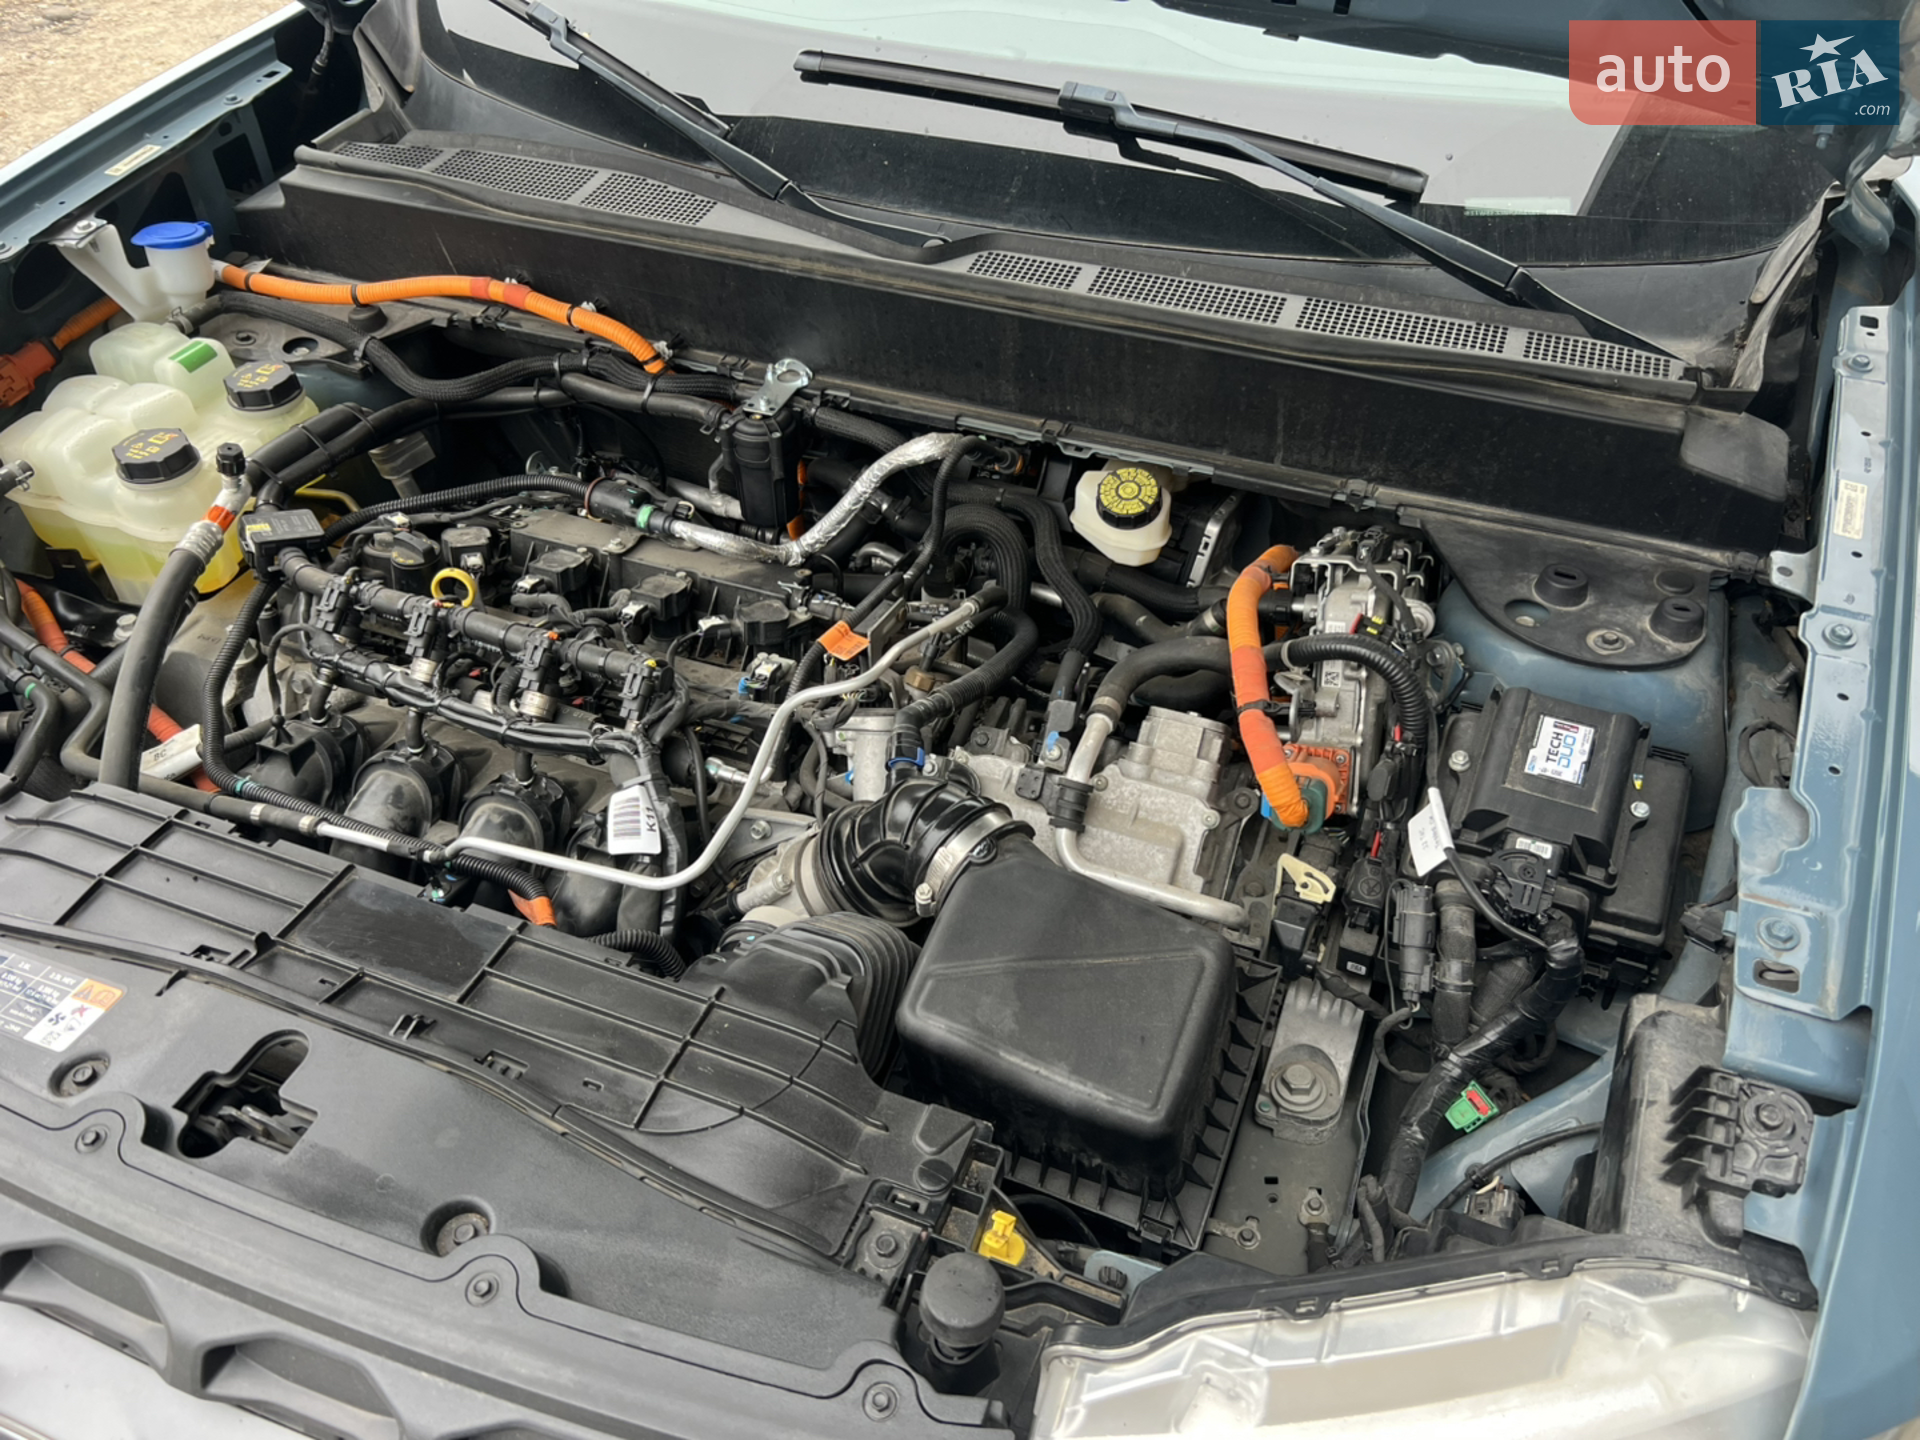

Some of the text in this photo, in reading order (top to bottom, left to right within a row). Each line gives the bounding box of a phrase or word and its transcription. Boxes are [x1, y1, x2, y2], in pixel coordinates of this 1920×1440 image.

[1545, 731, 1564, 763] TECH
[1557, 734, 1577, 769] DUO
[646, 806, 657, 833] K11
